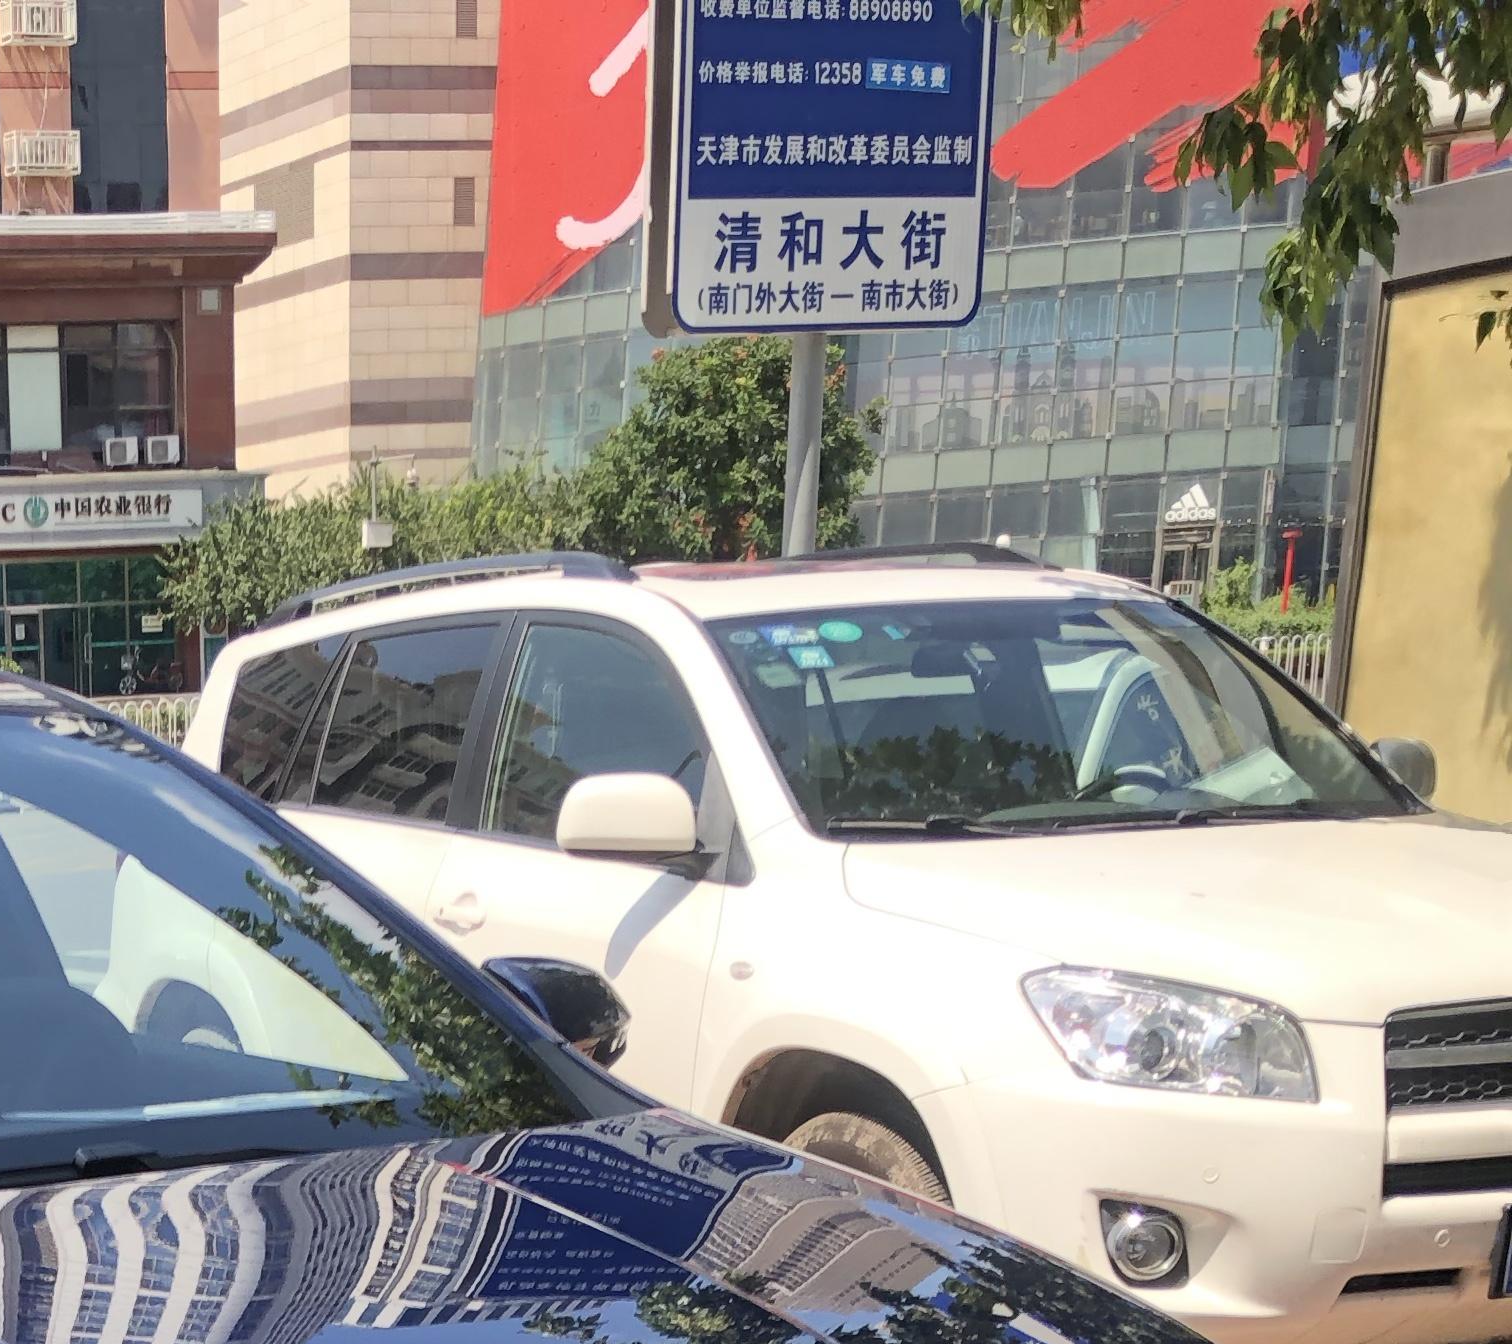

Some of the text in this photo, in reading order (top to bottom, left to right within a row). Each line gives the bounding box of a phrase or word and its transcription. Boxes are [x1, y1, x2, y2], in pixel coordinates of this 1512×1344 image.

[870, 62, 946, 88] 军车免费
[696, 134, 973, 166] 天津市发展和改革委员会监制
[714, 208, 947, 273] 清和大街
[54, 493, 173, 520] 中国农业银行
[1164, 507, 1217, 523] adidas
